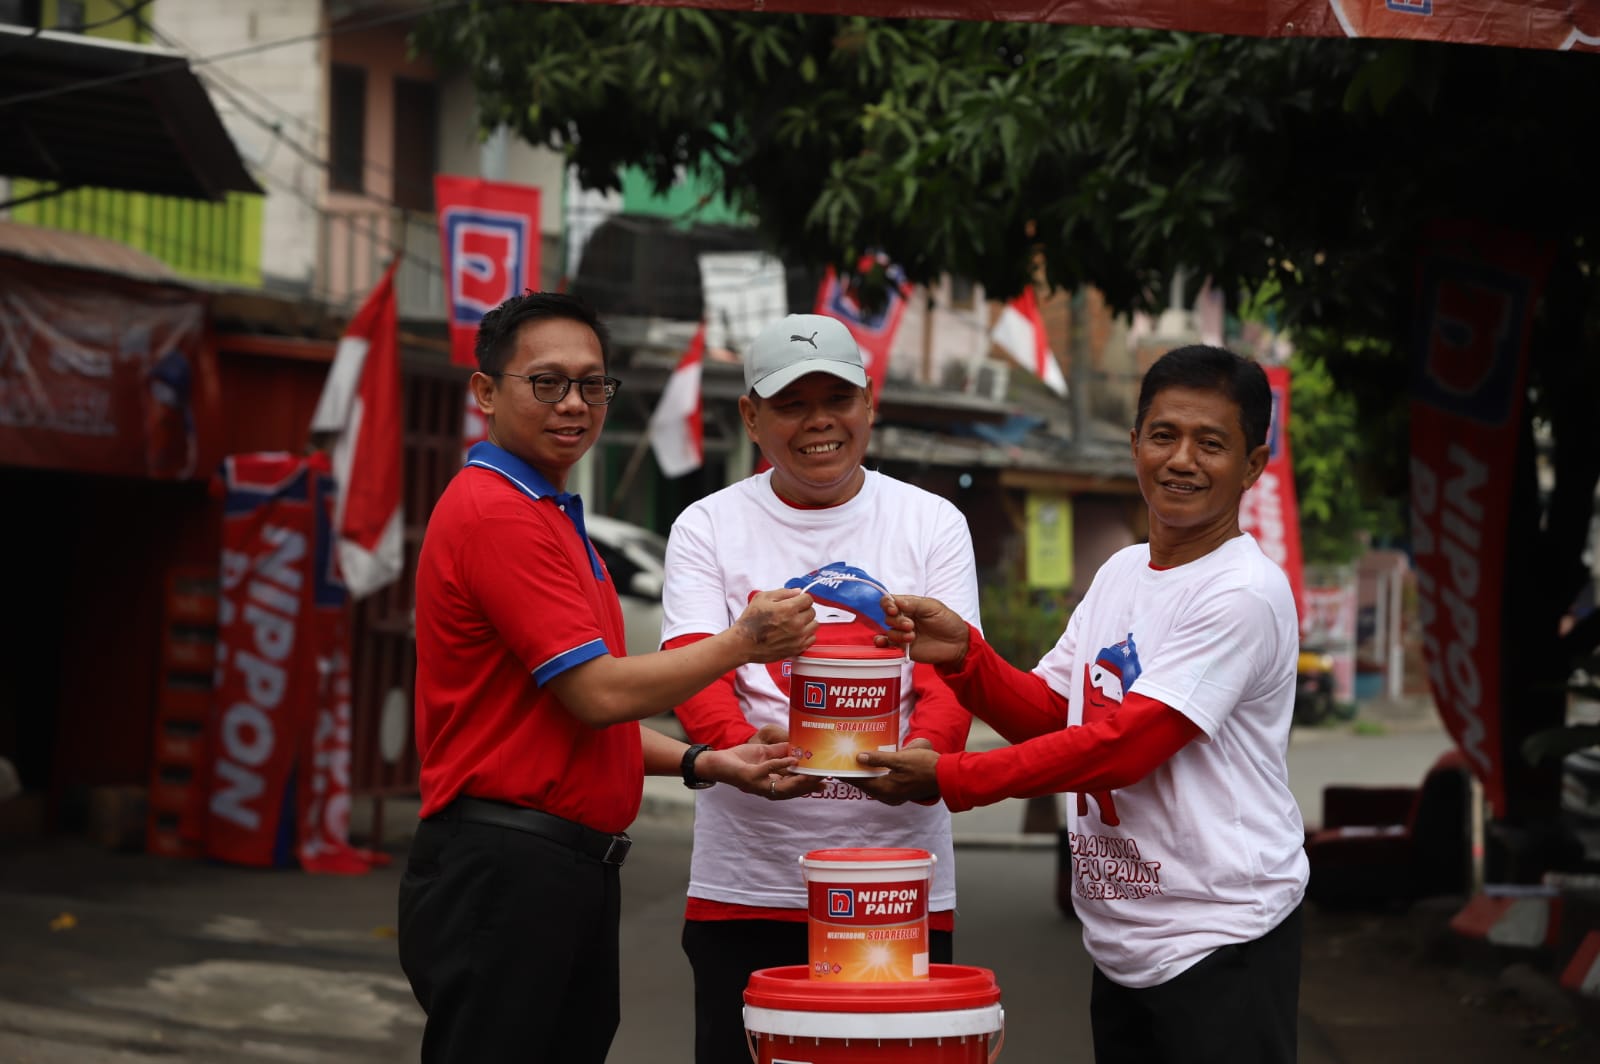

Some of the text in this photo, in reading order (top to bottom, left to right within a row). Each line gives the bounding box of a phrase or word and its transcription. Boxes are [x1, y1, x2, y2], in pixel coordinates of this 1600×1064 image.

[1441, 441, 1491, 774] NIPPON
[208, 522, 308, 832] NIPPON
[829, 686, 886, 698] NIPPON
[835, 698, 881, 708] PAINT
[1103, 860, 1161, 883] PAINT
[858, 889, 918, 903] NIPPON
[865, 902, 913, 915] PAINT
